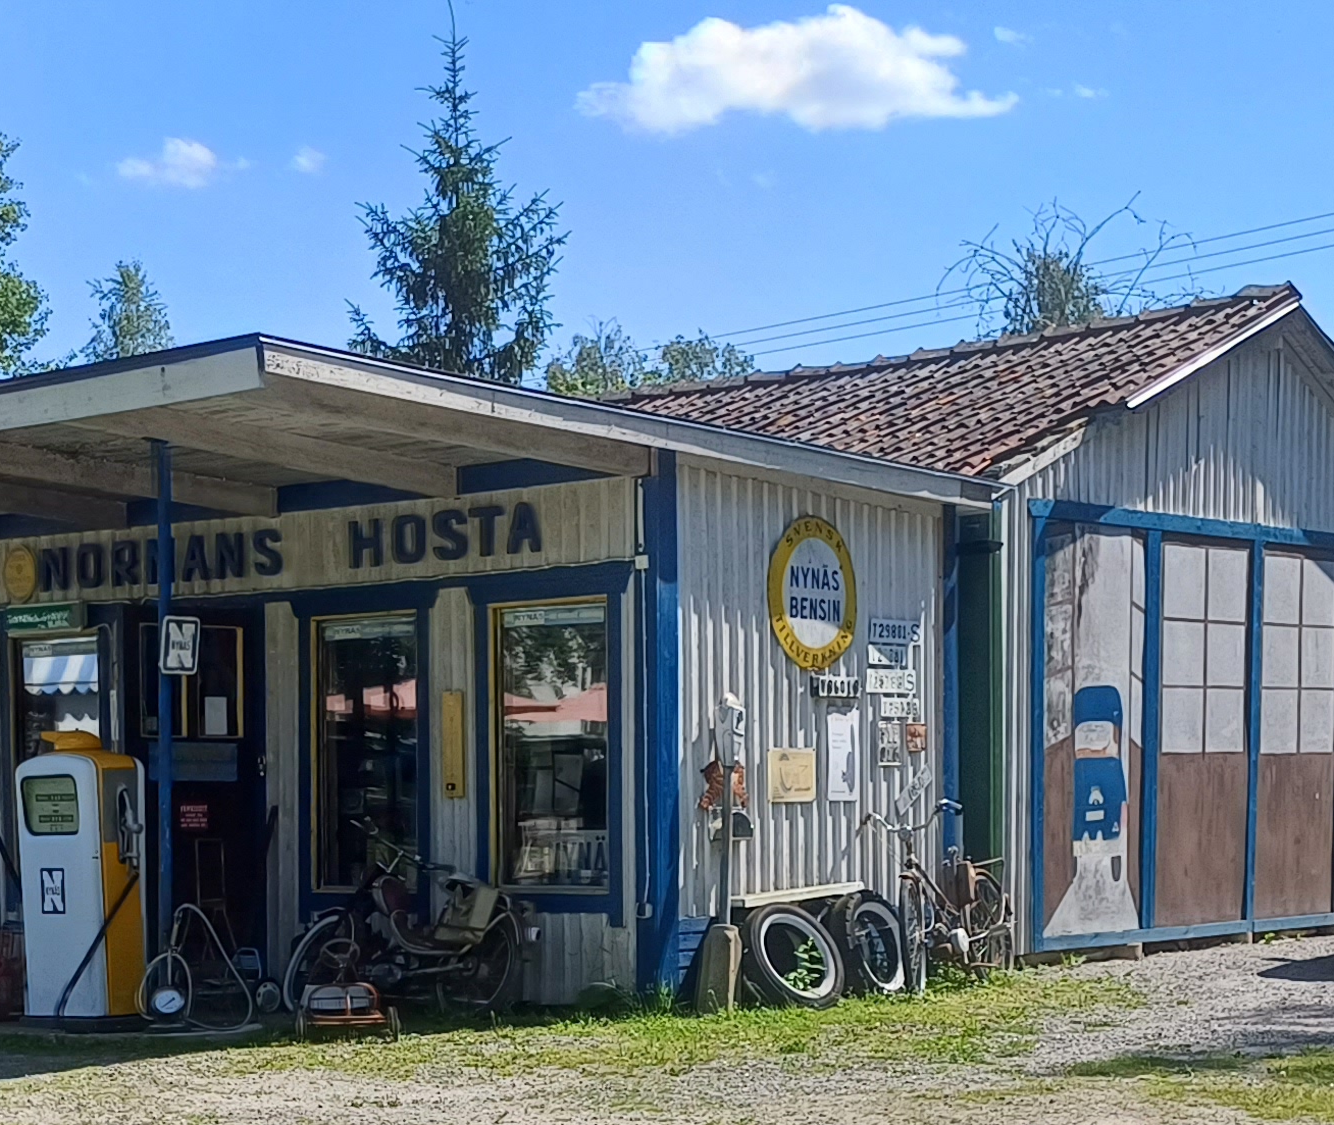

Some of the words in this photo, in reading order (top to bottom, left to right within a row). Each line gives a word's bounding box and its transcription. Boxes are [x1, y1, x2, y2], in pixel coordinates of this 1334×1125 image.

[348, 502, 542, 569] HOSTA
[790, 564, 840, 591] NYNÄS
[790, 596, 840, 622] BENSIN
